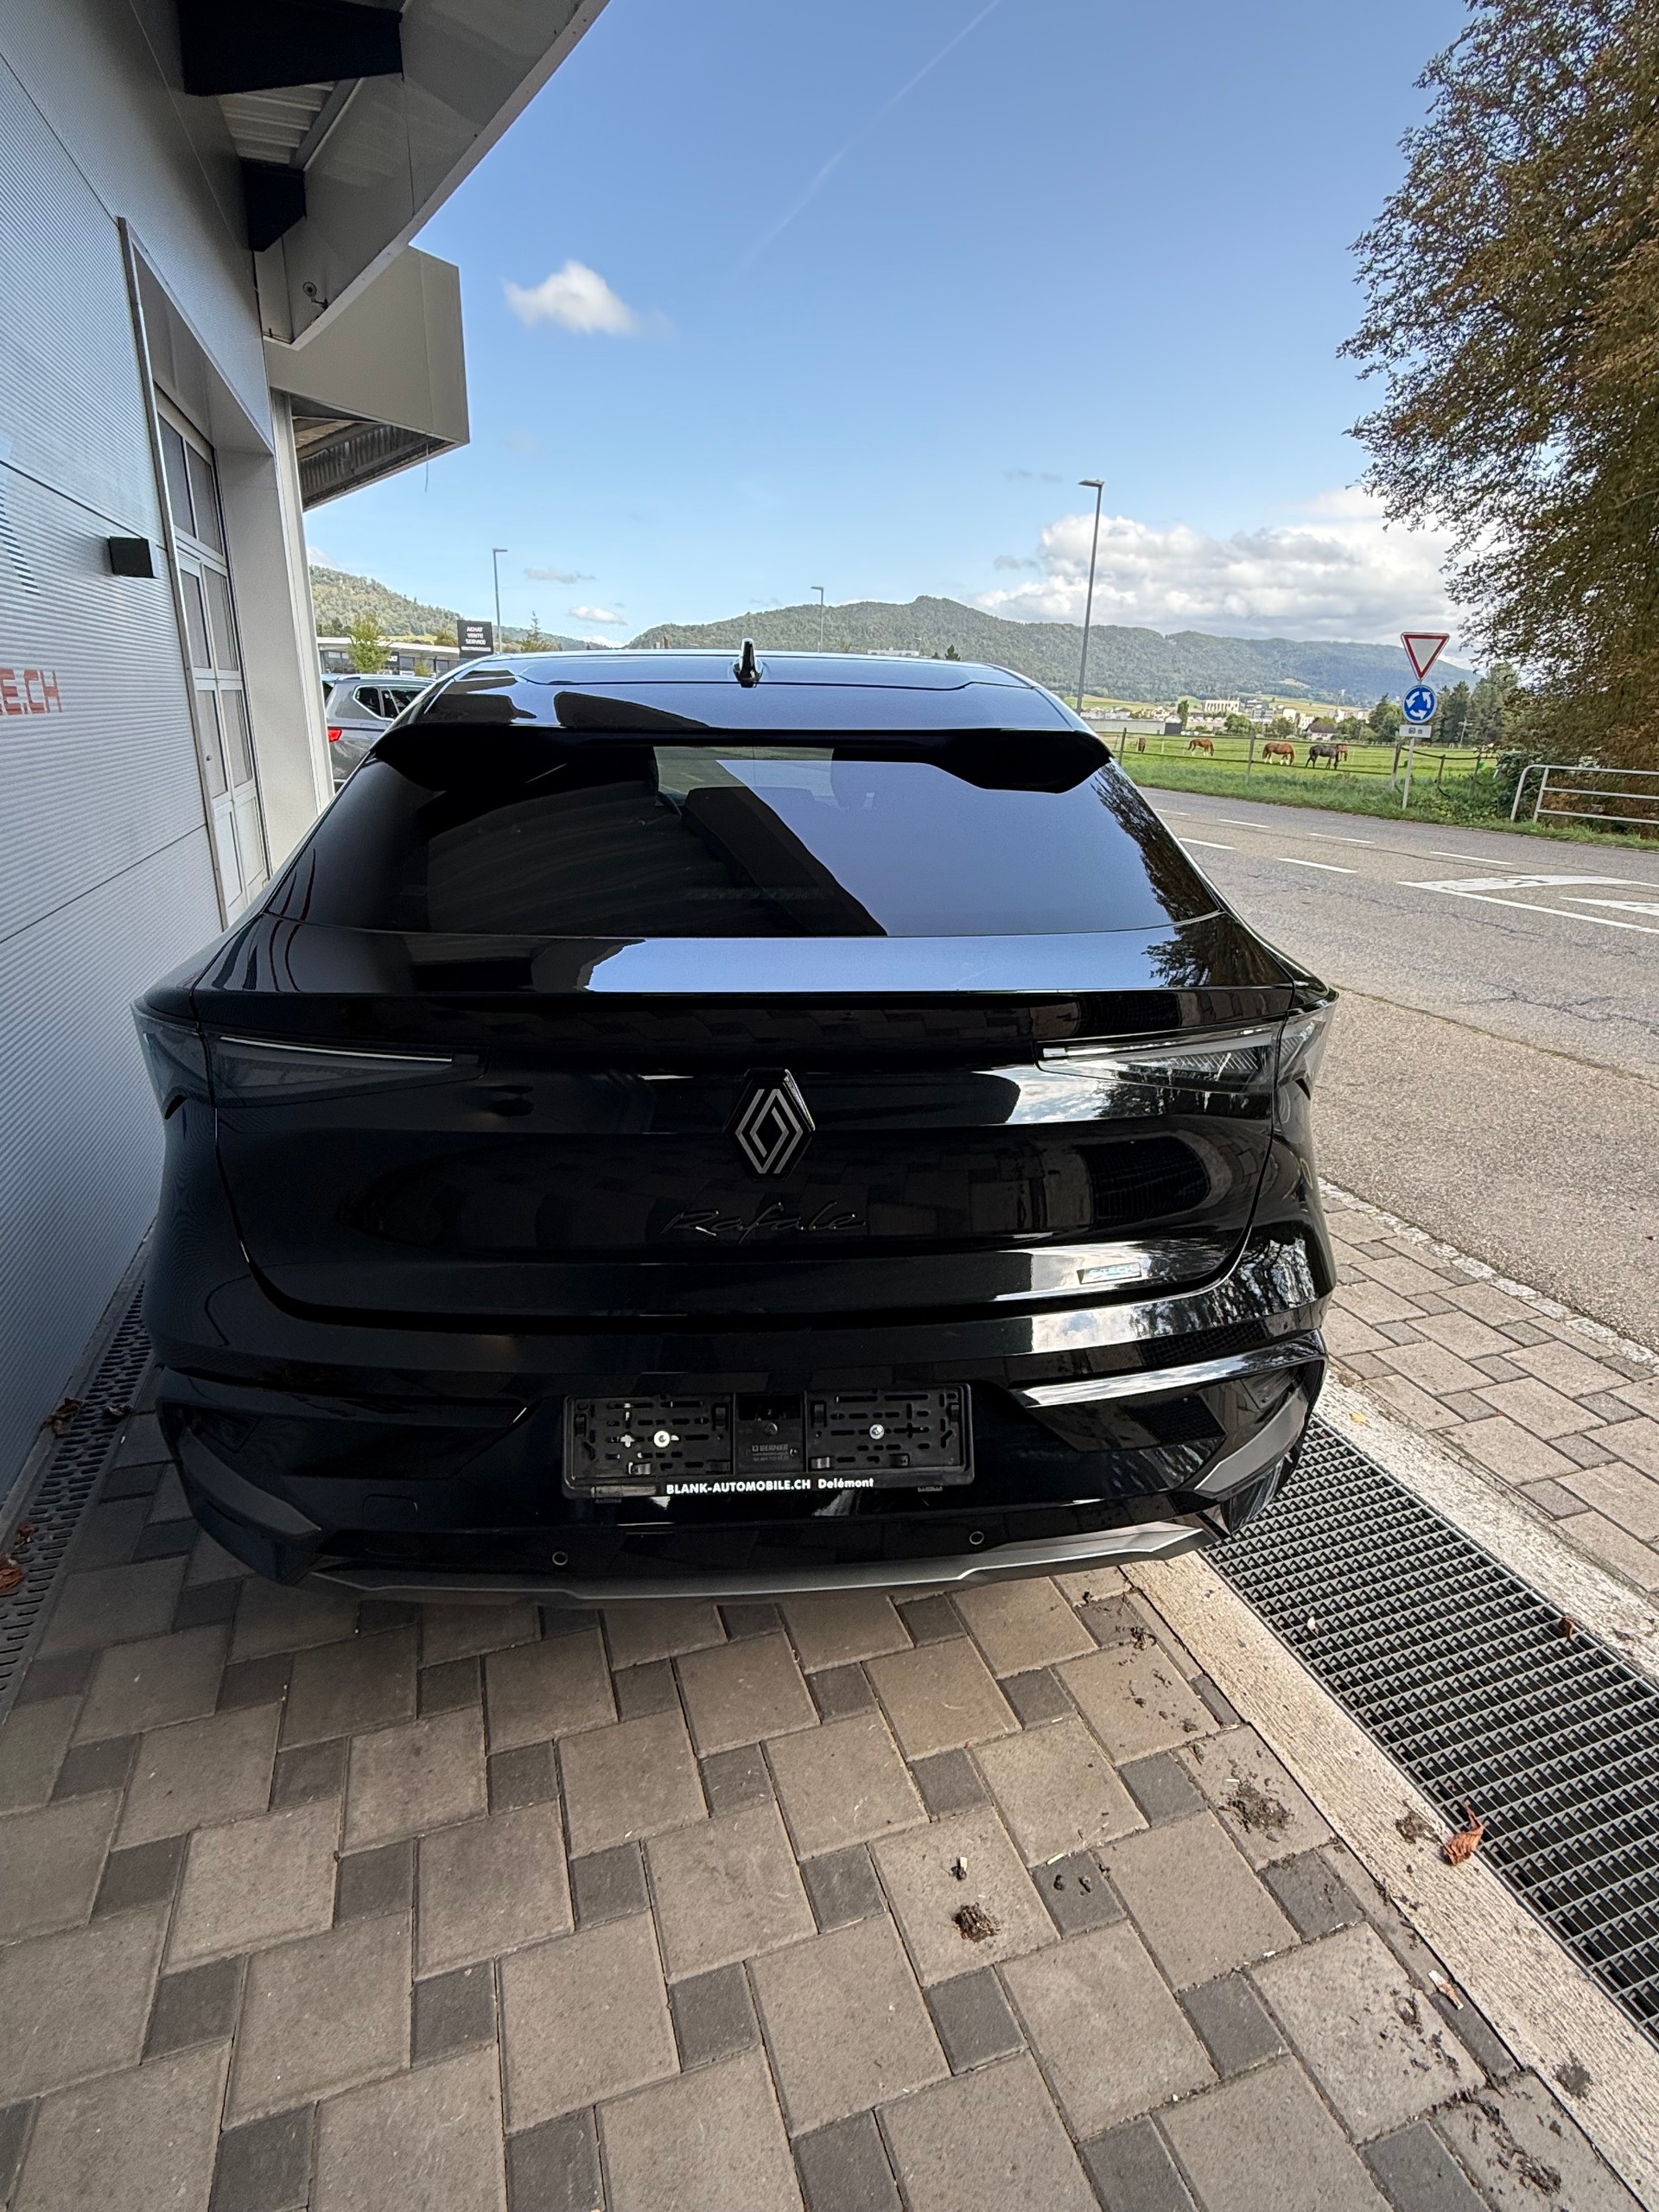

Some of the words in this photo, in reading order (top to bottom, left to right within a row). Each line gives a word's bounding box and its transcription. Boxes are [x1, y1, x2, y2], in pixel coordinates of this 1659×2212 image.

[659, 1201, 867, 1244] Rafale
[666, 1479, 811, 1494] BLANK-AUTOMOBILE.CH
[817, 1478, 874, 1489] Delémont
